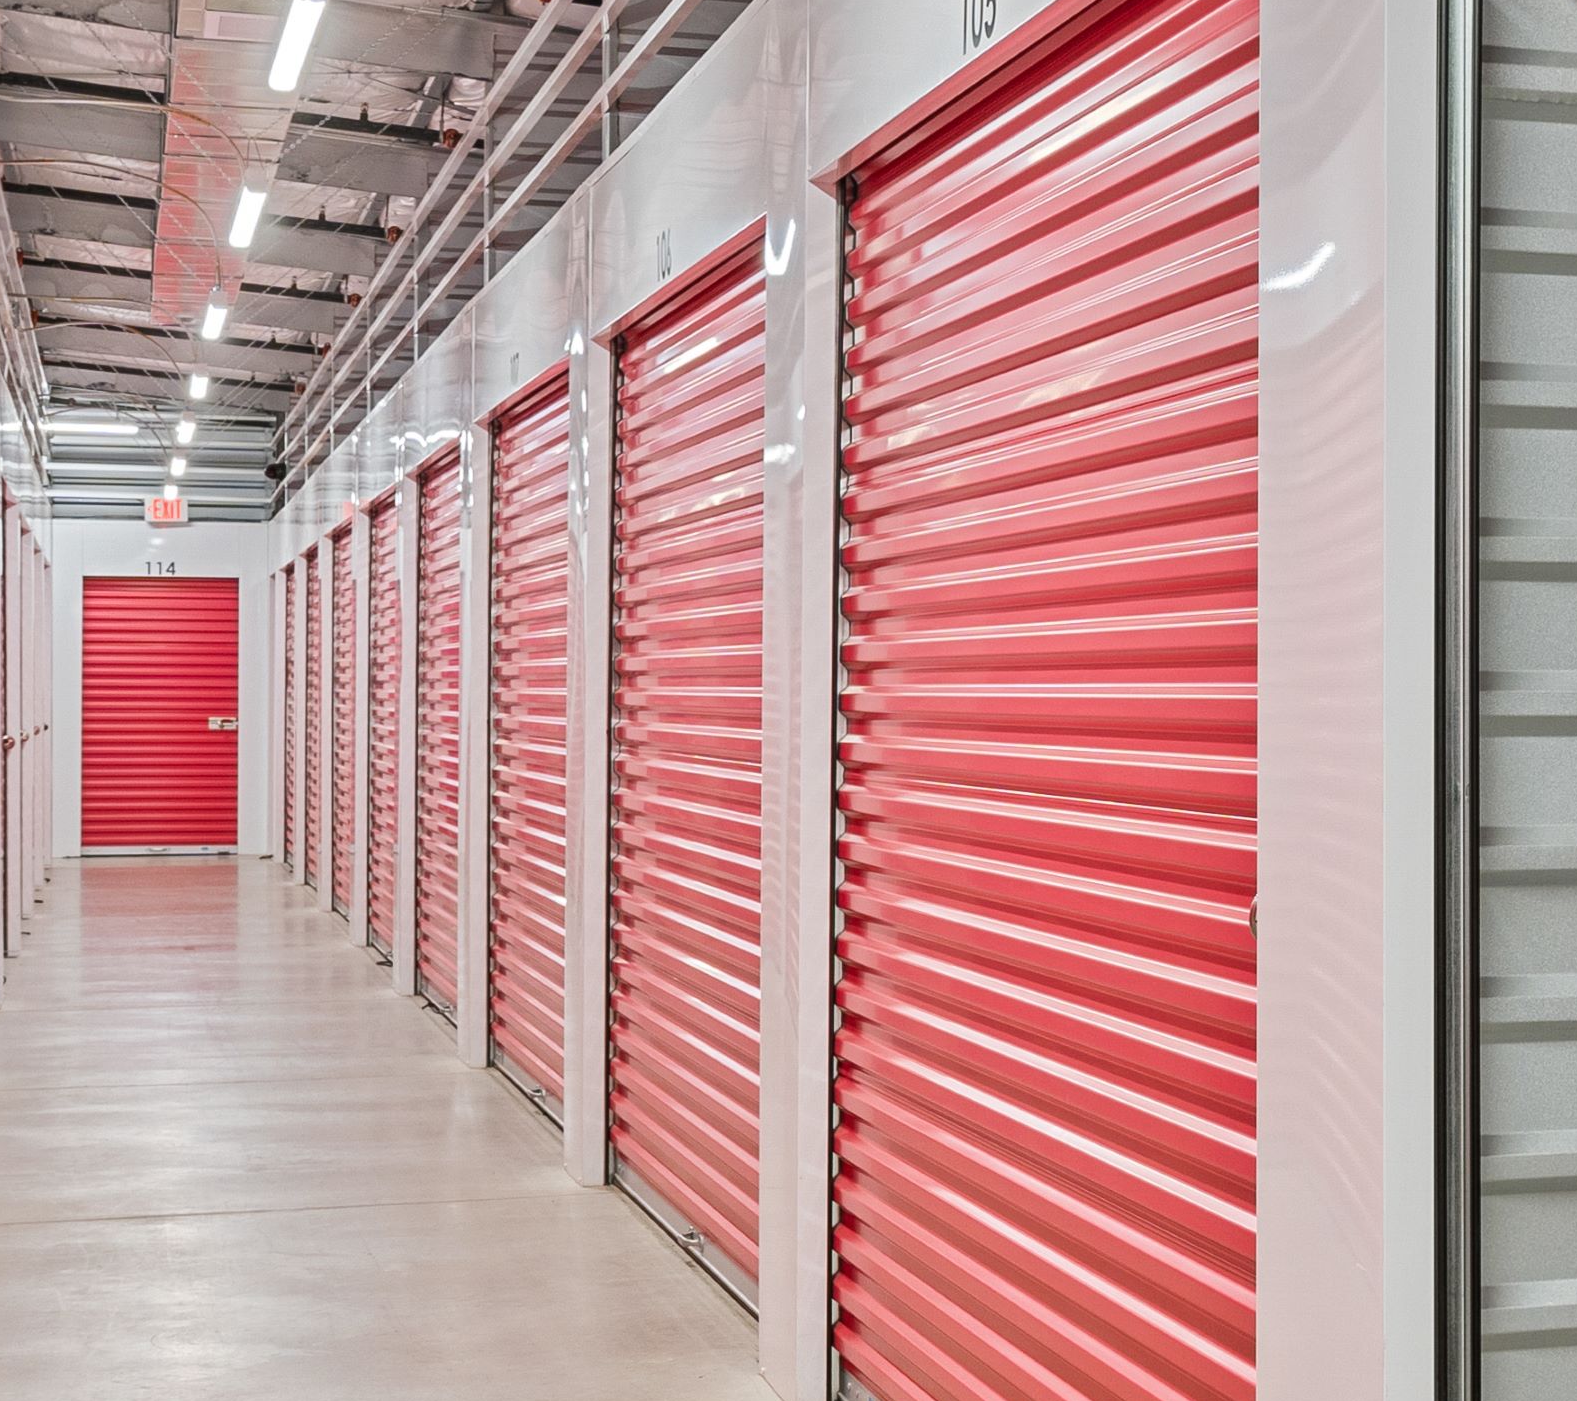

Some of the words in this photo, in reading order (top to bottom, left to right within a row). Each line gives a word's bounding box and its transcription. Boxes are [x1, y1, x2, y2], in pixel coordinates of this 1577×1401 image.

[656, 228, 672, 282] 106
[152, 498, 183, 519] EXIT
[145, 561, 176, 575] 114
